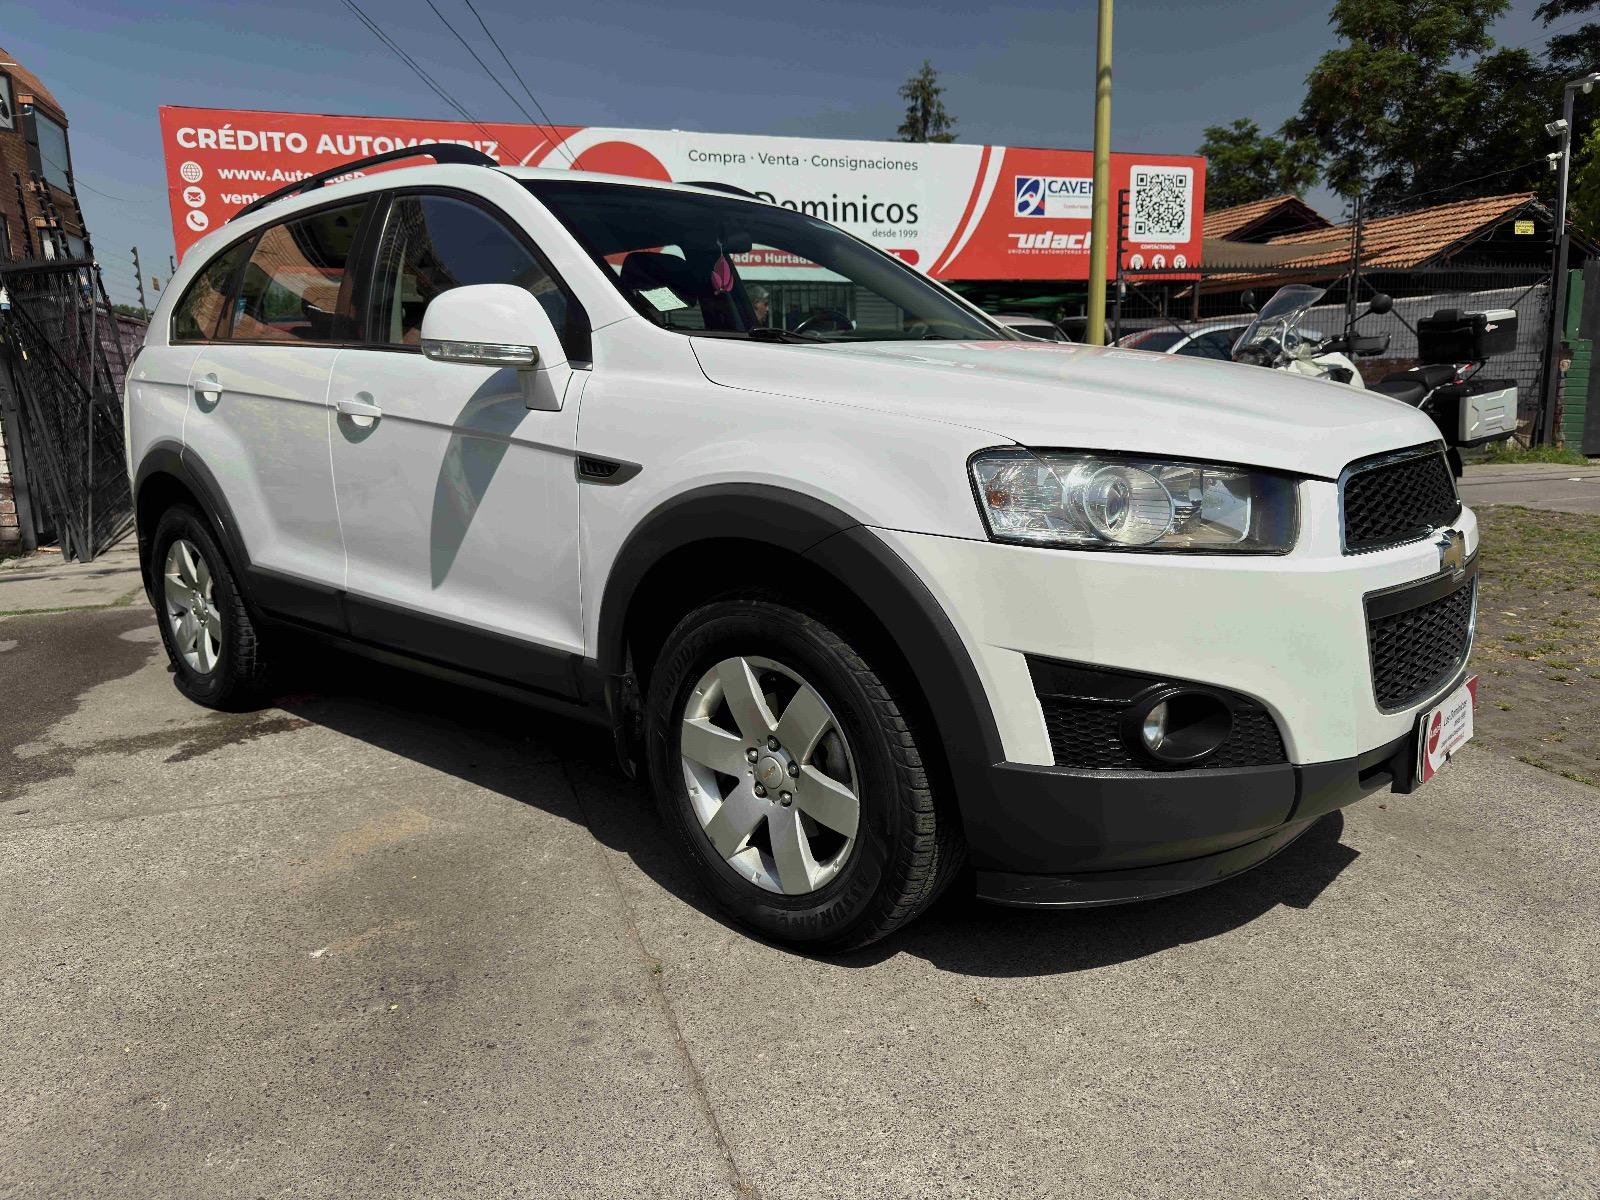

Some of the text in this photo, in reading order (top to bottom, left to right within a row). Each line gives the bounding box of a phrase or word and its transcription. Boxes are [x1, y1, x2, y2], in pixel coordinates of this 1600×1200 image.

[176, 123, 308, 154] CRÉDITO
[688, 149, 919, 171] Compra Venta Consignaciones
[872, 228, 919, 239] desde 1999
